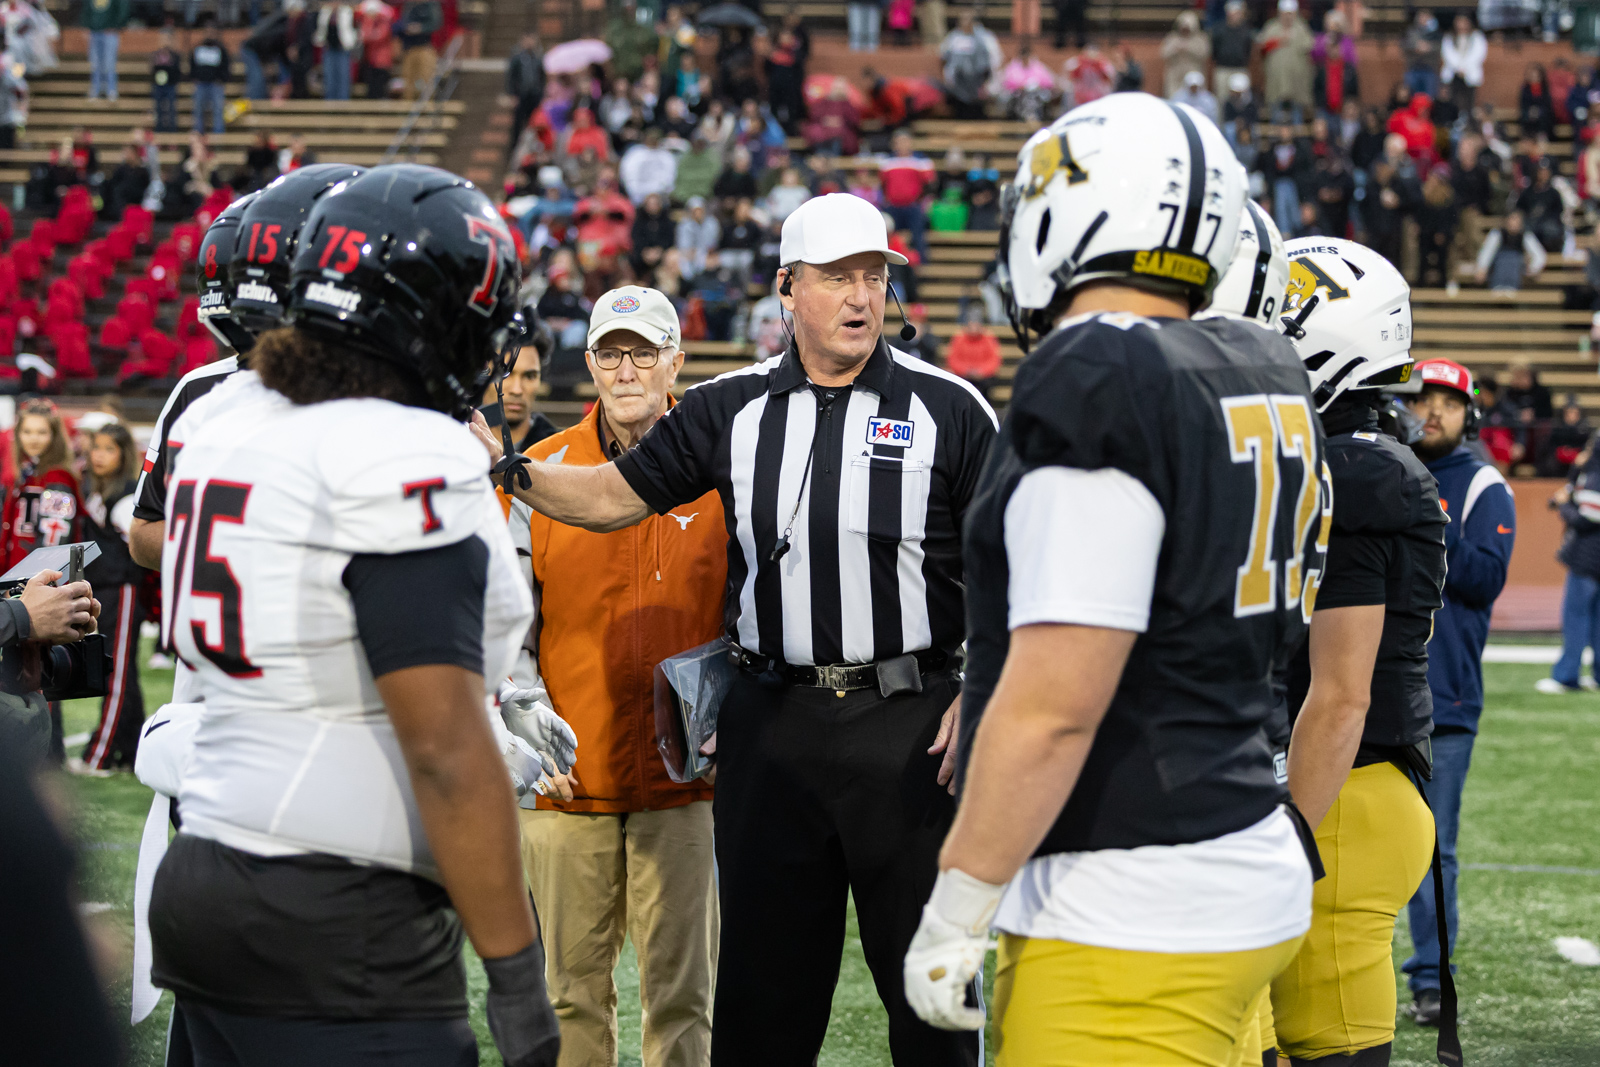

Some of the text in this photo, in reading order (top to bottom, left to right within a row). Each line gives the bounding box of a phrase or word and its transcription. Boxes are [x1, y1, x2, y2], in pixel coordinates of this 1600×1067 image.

[205, 244, 218, 279] 8
[247, 223, 281, 264] 15
[318, 225, 367, 274] 75
[1262, 296, 1276, 324] 9
[402, 476, 447, 536] T
[1220, 394, 1322, 618] 77
[165, 478, 264, 679] 75
